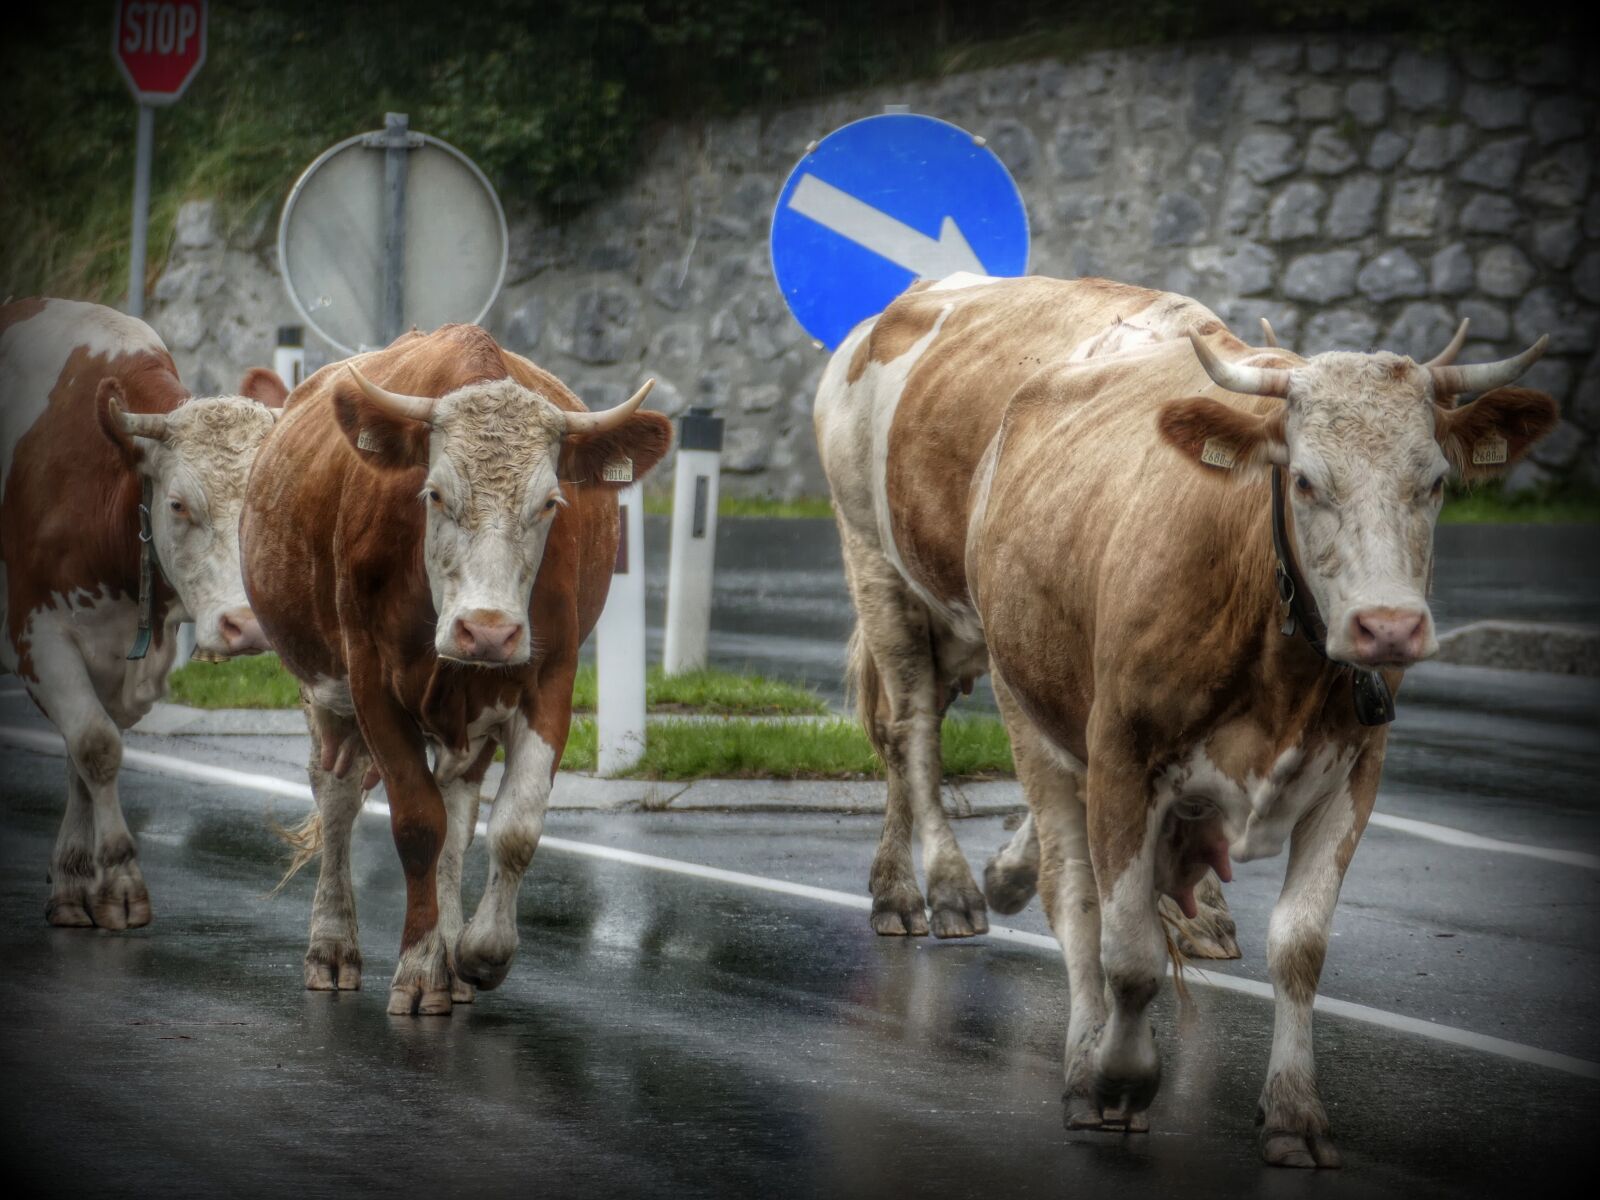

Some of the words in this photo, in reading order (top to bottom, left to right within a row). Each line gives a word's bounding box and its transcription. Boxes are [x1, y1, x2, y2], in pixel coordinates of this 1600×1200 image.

[124, 2, 197, 55] STOP
[1203, 448, 1226, 465] 2680
[1474, 450, 1496, 462] 2680
[604, 469, 623, 480] 9010
